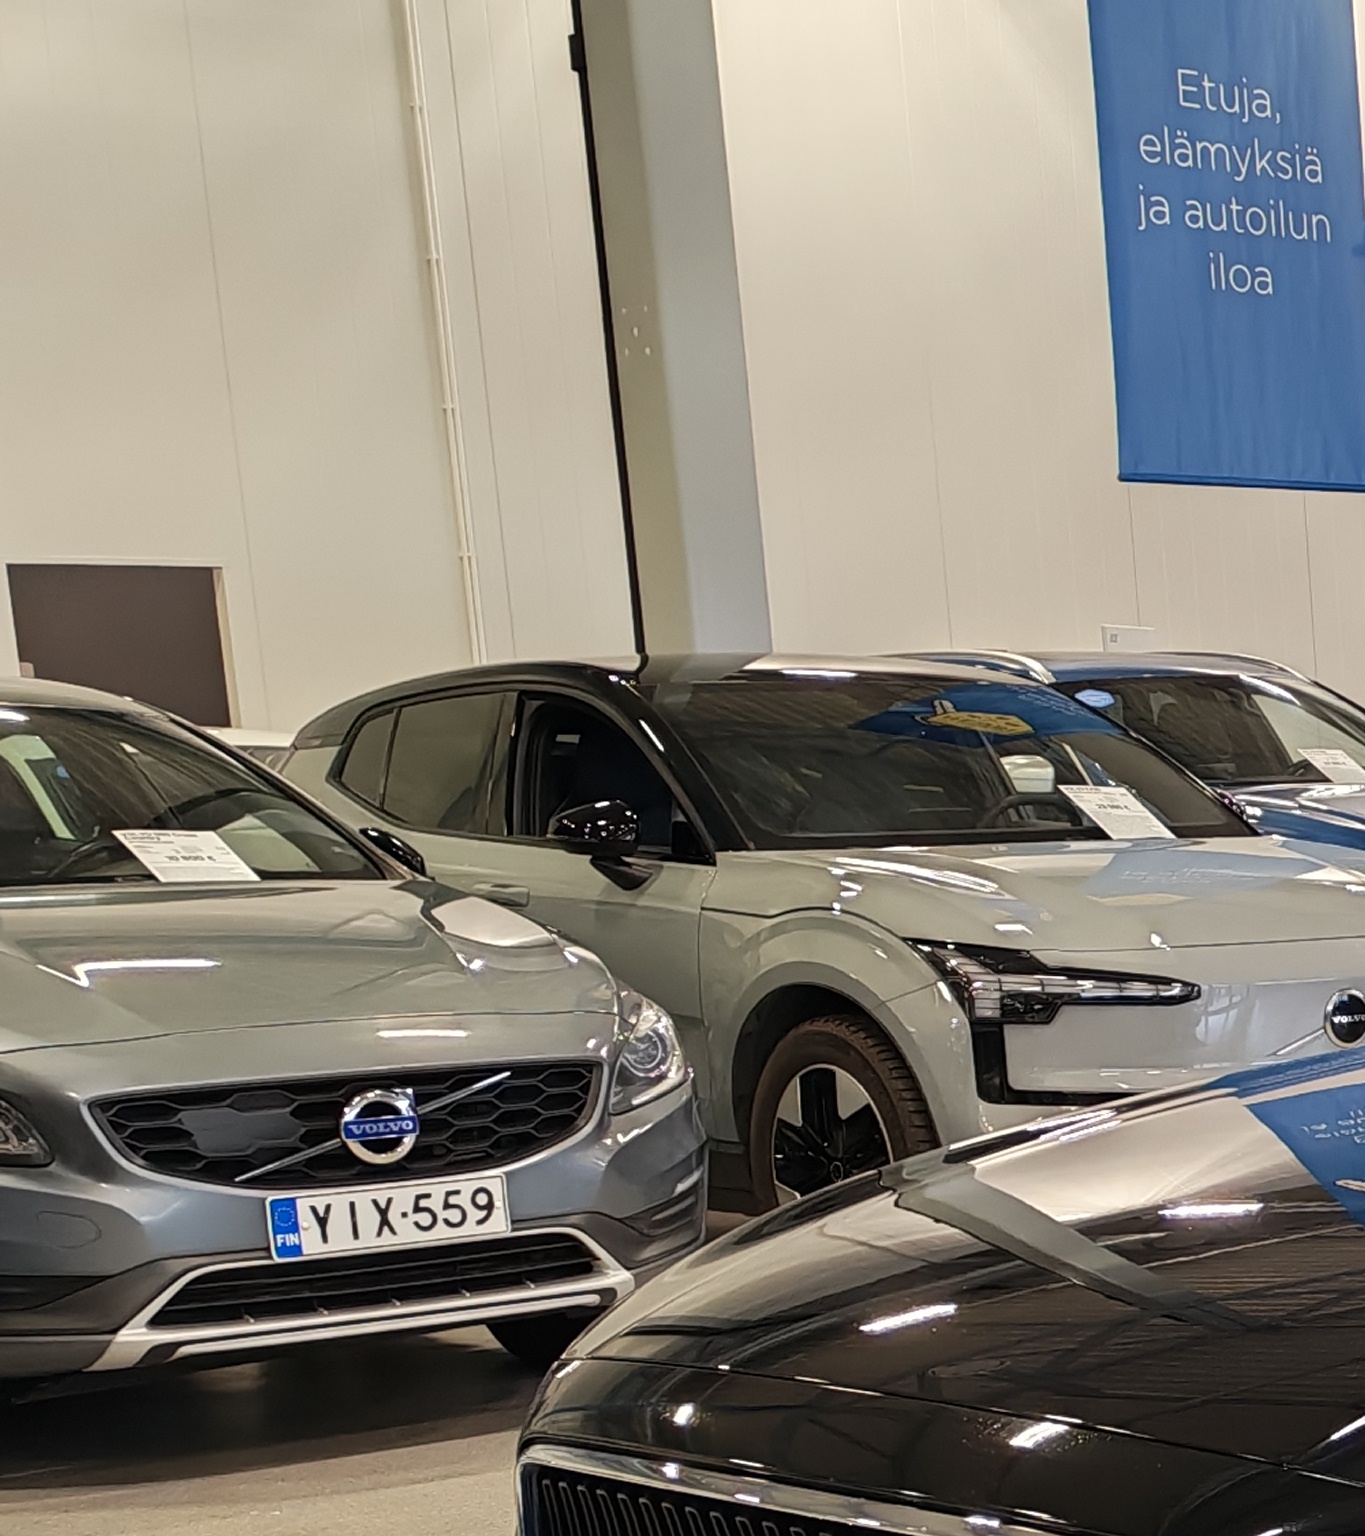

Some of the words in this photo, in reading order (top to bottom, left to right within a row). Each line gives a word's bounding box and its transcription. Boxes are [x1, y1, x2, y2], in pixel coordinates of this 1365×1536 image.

[1176, 68, 1282, 125] Etuja,
[1138, 127, 1324, 186] elämyksiä
[1137, 187, 1172, 229] ja
[1183, 193, 1332, 244] autoilun
[1208, 250, 1274, 297] iloa
[347, 1119, 415, 1136] VOLVO
[276, 1232, 300, 1248] FIN
[309, 1186, 495, 1244] YIX-559
